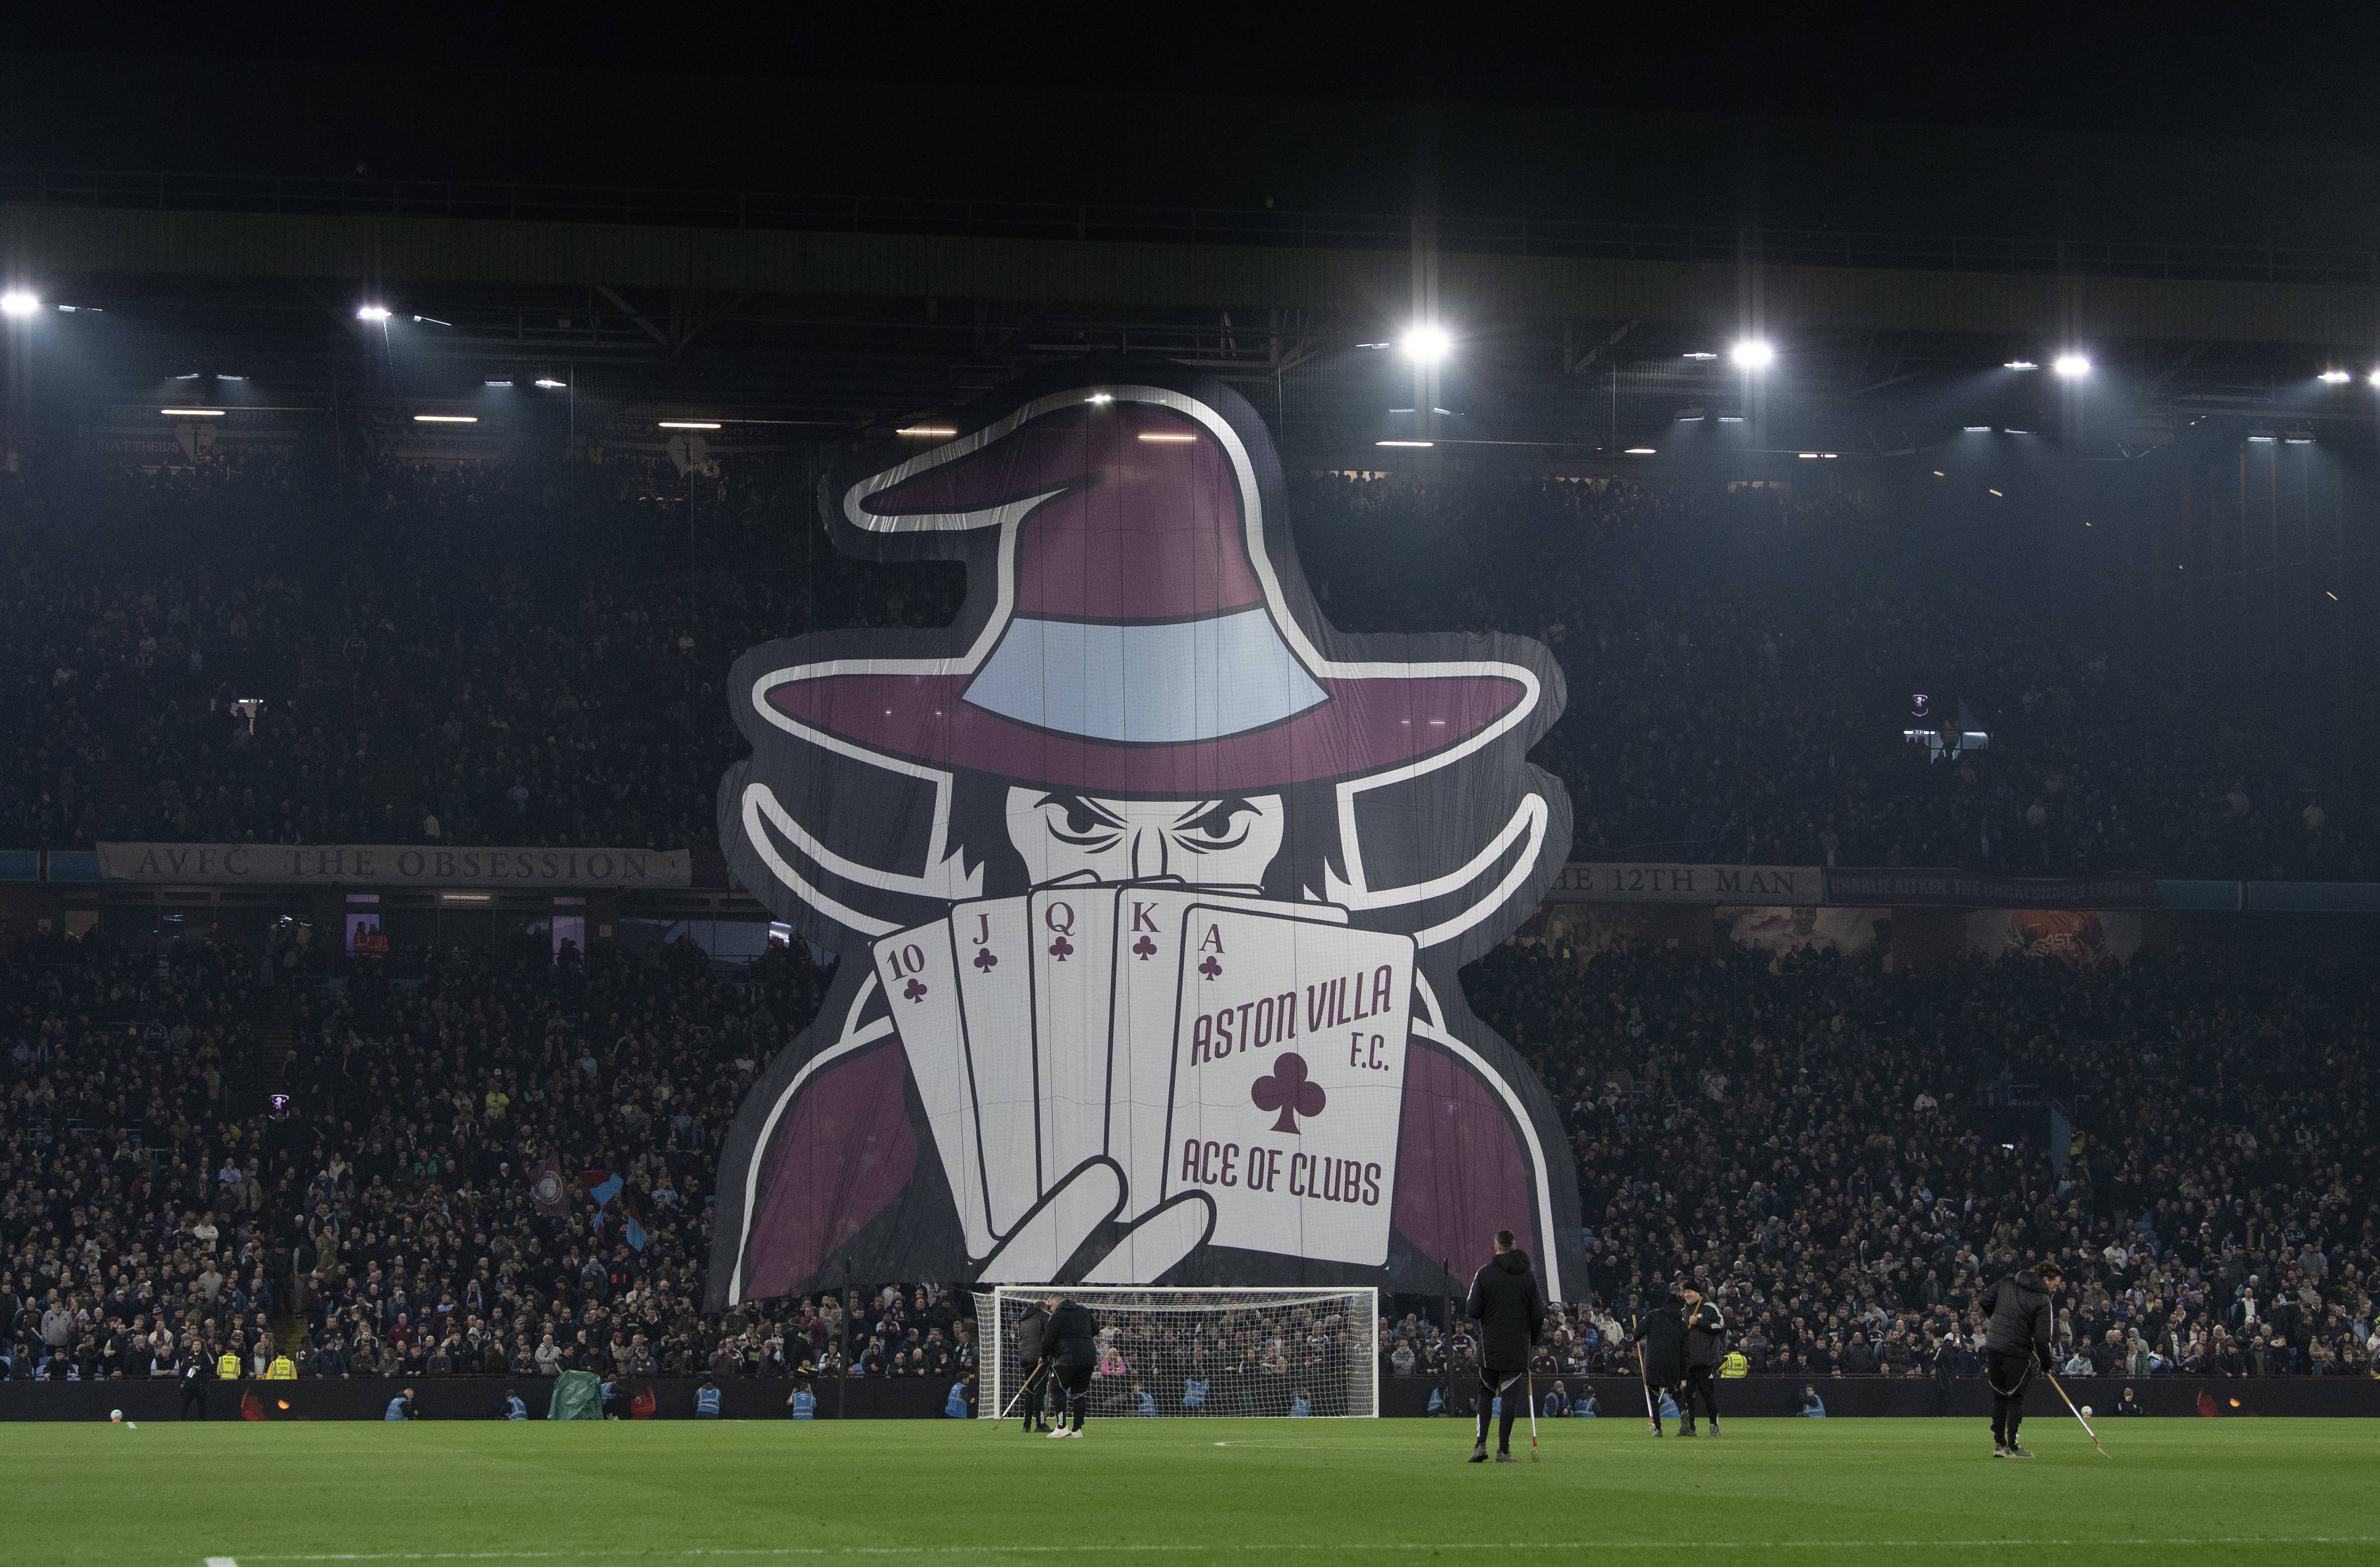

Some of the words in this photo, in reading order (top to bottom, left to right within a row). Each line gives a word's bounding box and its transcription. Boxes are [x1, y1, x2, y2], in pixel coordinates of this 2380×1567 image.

[138, 849, 249, 875] AVFC
[285, 850, 375, 876] THE
[397, 851, 647, 880] OBSESSION
[1551, 868, 1593, 890] HE
[1612, 869, 1696, 891] 12TH
[1714, 870, 1796, 894] MAN
[1830, 877, 1891, 893] CHARLIE
[1953, 879, 1980, 896] THE
[973, 913, 990, 945] J
[1045, 901, 1076, 937] Q
[1131, 901, 1161, 933] K
[1198, 923, 1225, 954] A
[887, 944, 925, 980] 10
[1190, 991, 1297, 1067] ASTON
[1307, 964, 1392, 1033] VILLA
[1350, 1031, 1389, 1071] F.C.
[1181, 1138, 1240, 1187] ACE
[1247, 1146, 1283, 1193] OF
[1289, 1152, 1382, 1206] CLUBS
